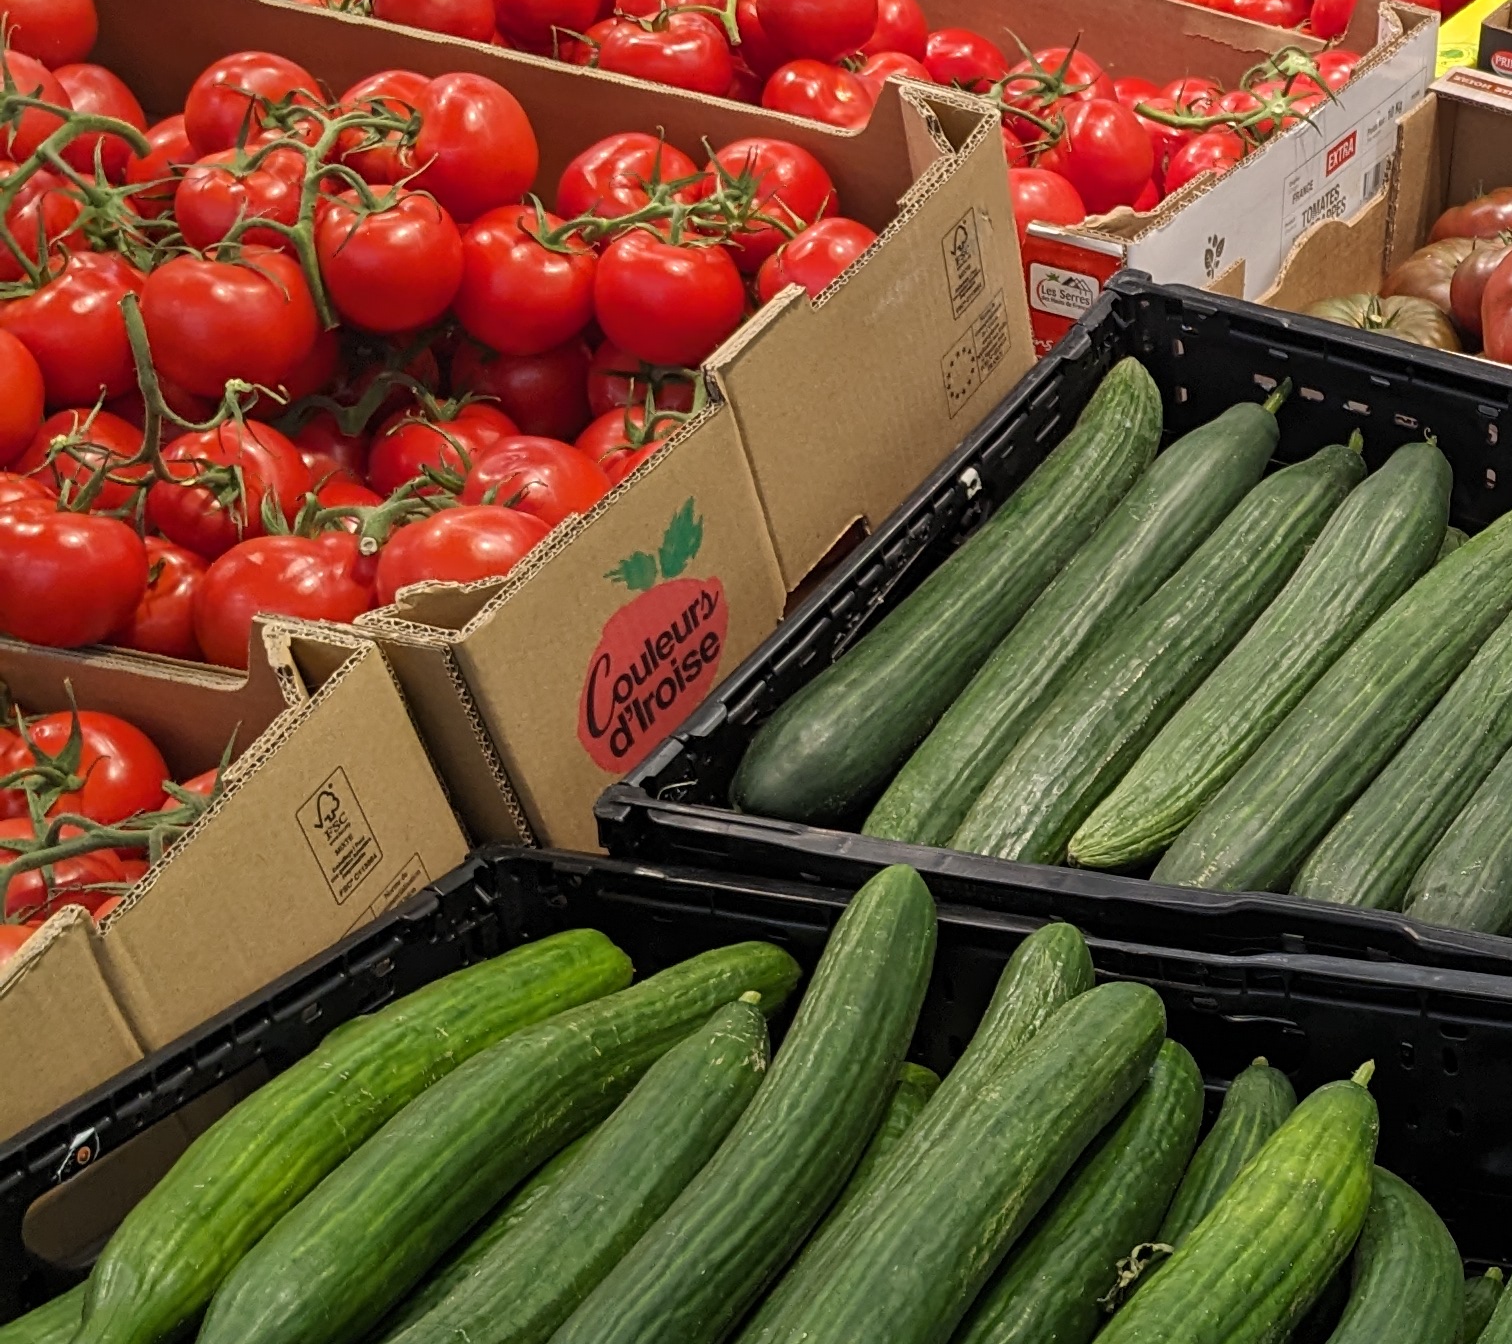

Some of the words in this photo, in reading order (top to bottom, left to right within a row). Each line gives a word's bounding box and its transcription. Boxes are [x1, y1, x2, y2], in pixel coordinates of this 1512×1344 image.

[1328, 137, 1354, 171] EXTRA
[1292, 180, 1313, 205] FRANCE
[1302, 183, 1340, 229] TOMATES
[1041, 285, 1057, 297] Les
[1060, 289, 1090, 306] Serres
[587, 589, 719, 738] Couleurs
[610, 631, 721, 758] d'Iroise
[324, 811, 348, 841] FSC
